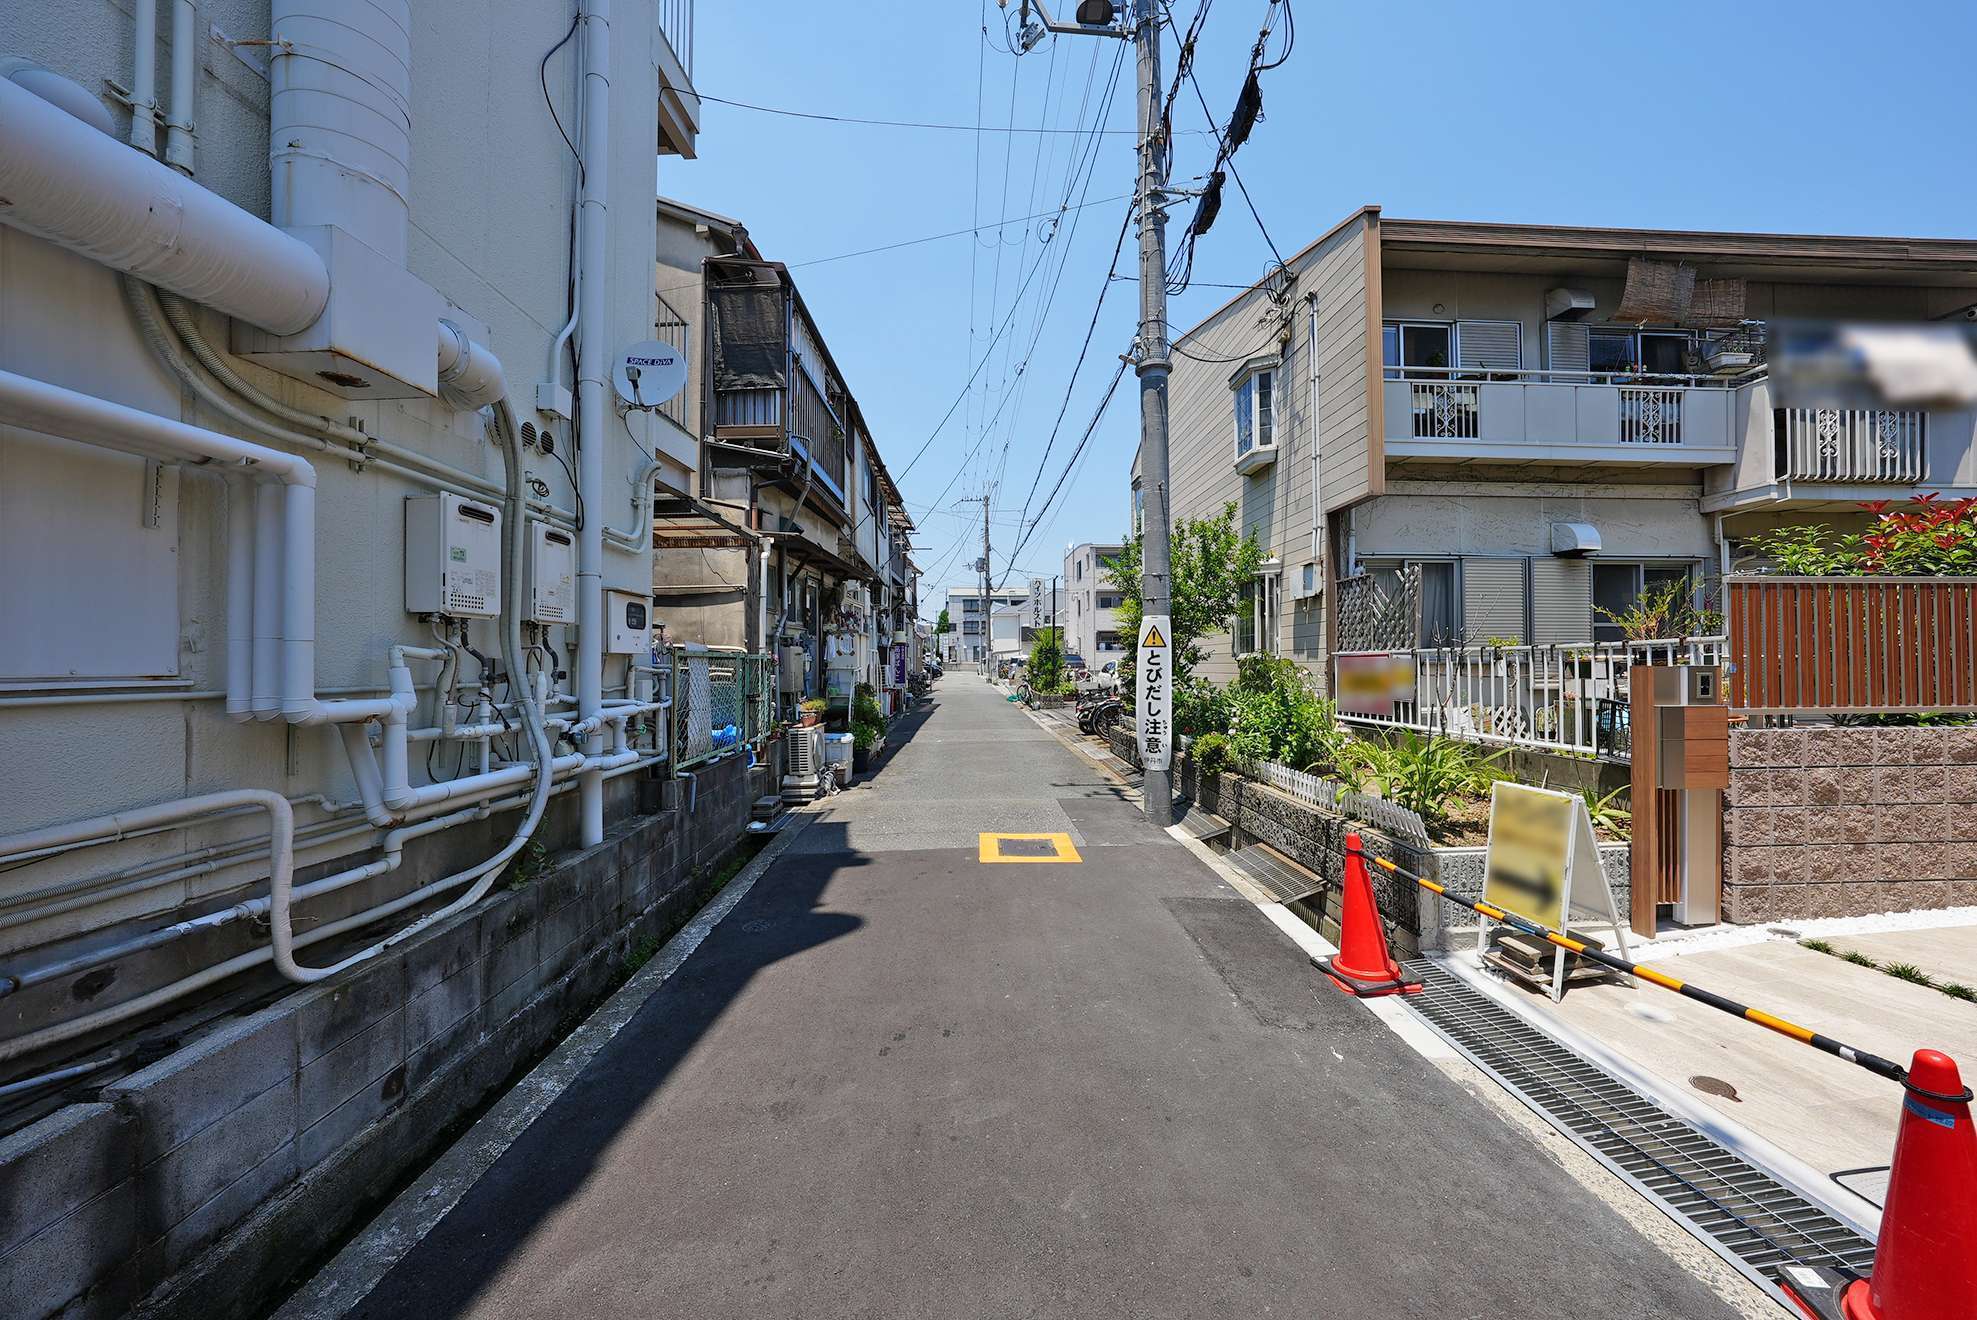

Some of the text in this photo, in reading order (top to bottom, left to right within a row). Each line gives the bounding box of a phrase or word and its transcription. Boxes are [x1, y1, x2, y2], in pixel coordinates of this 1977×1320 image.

[629, 357, 651, 366] SPACE
[1033, 580, 1042, 628] ハイツホルスト
[1145, 649, 1162, 754] とびだし注意
